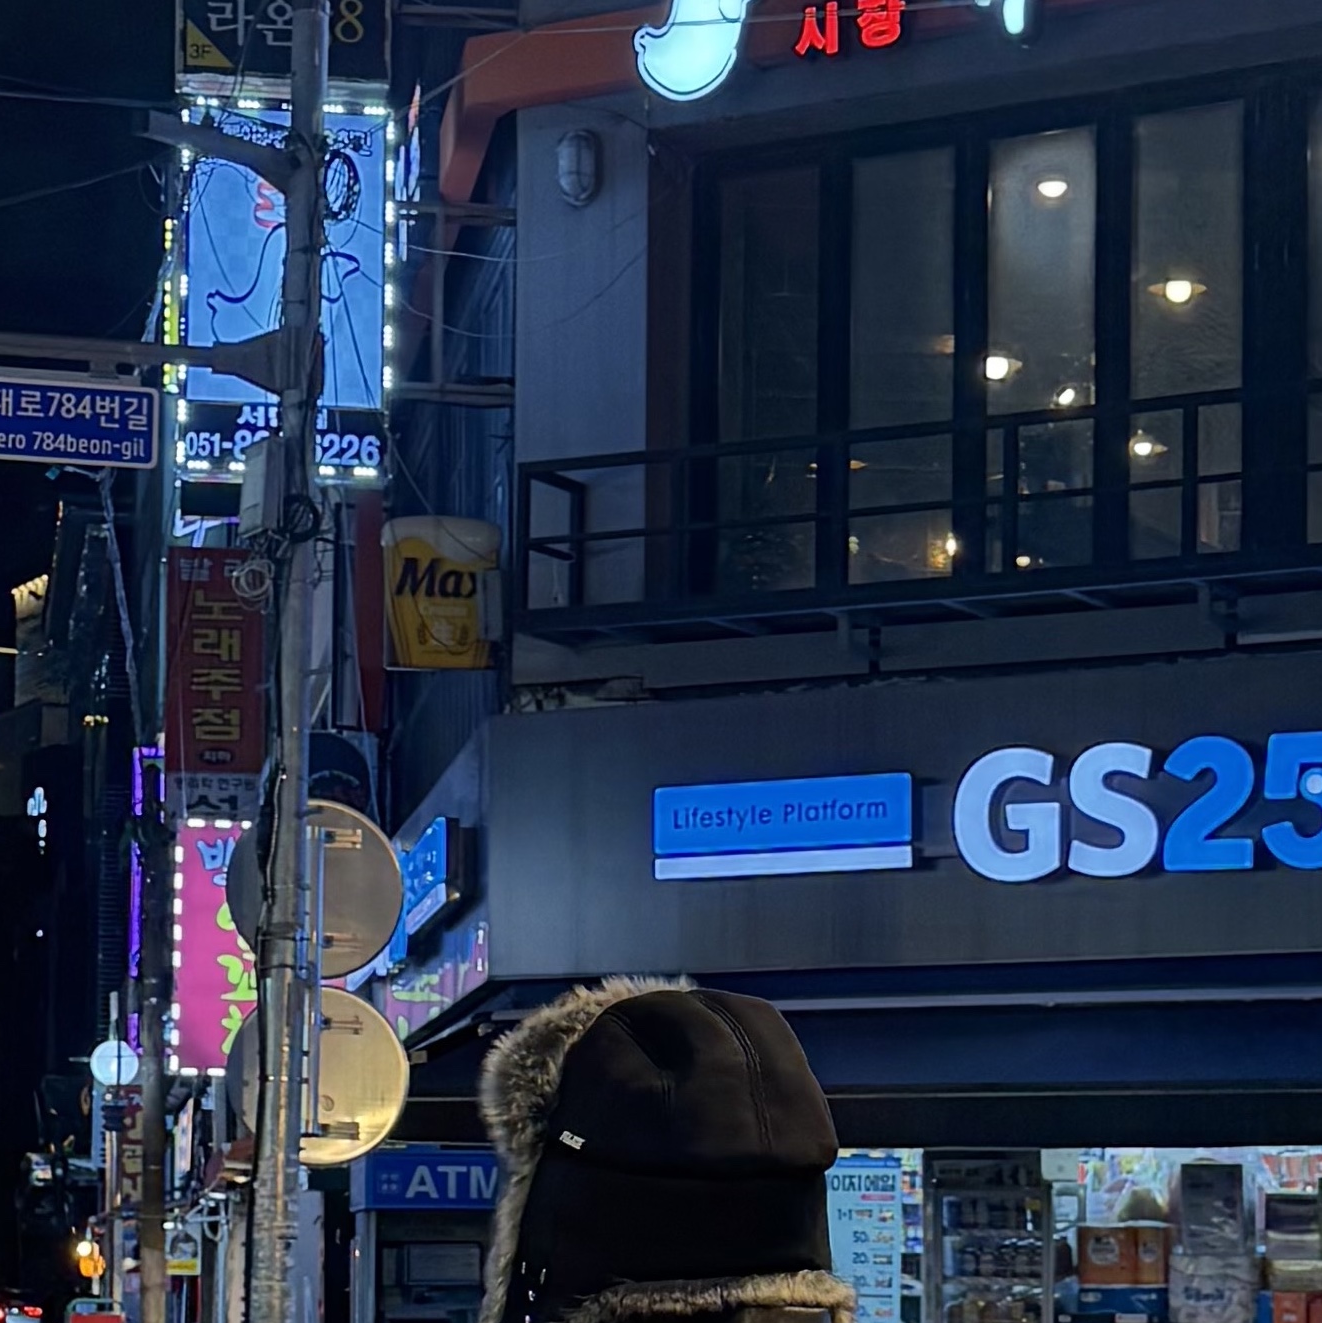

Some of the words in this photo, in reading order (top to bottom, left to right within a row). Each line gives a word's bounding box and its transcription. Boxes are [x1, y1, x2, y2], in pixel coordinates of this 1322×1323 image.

[189, 43, 212, 60] 3F
[32, 431, 146, 460] 784beon-gil
[191, 589, 244, 742] 노래주점
[672, 800, 773, 831] Lifestyle
[781, 796, 889, 826] Platform
[405, 1165, 499, 1199] ATM
